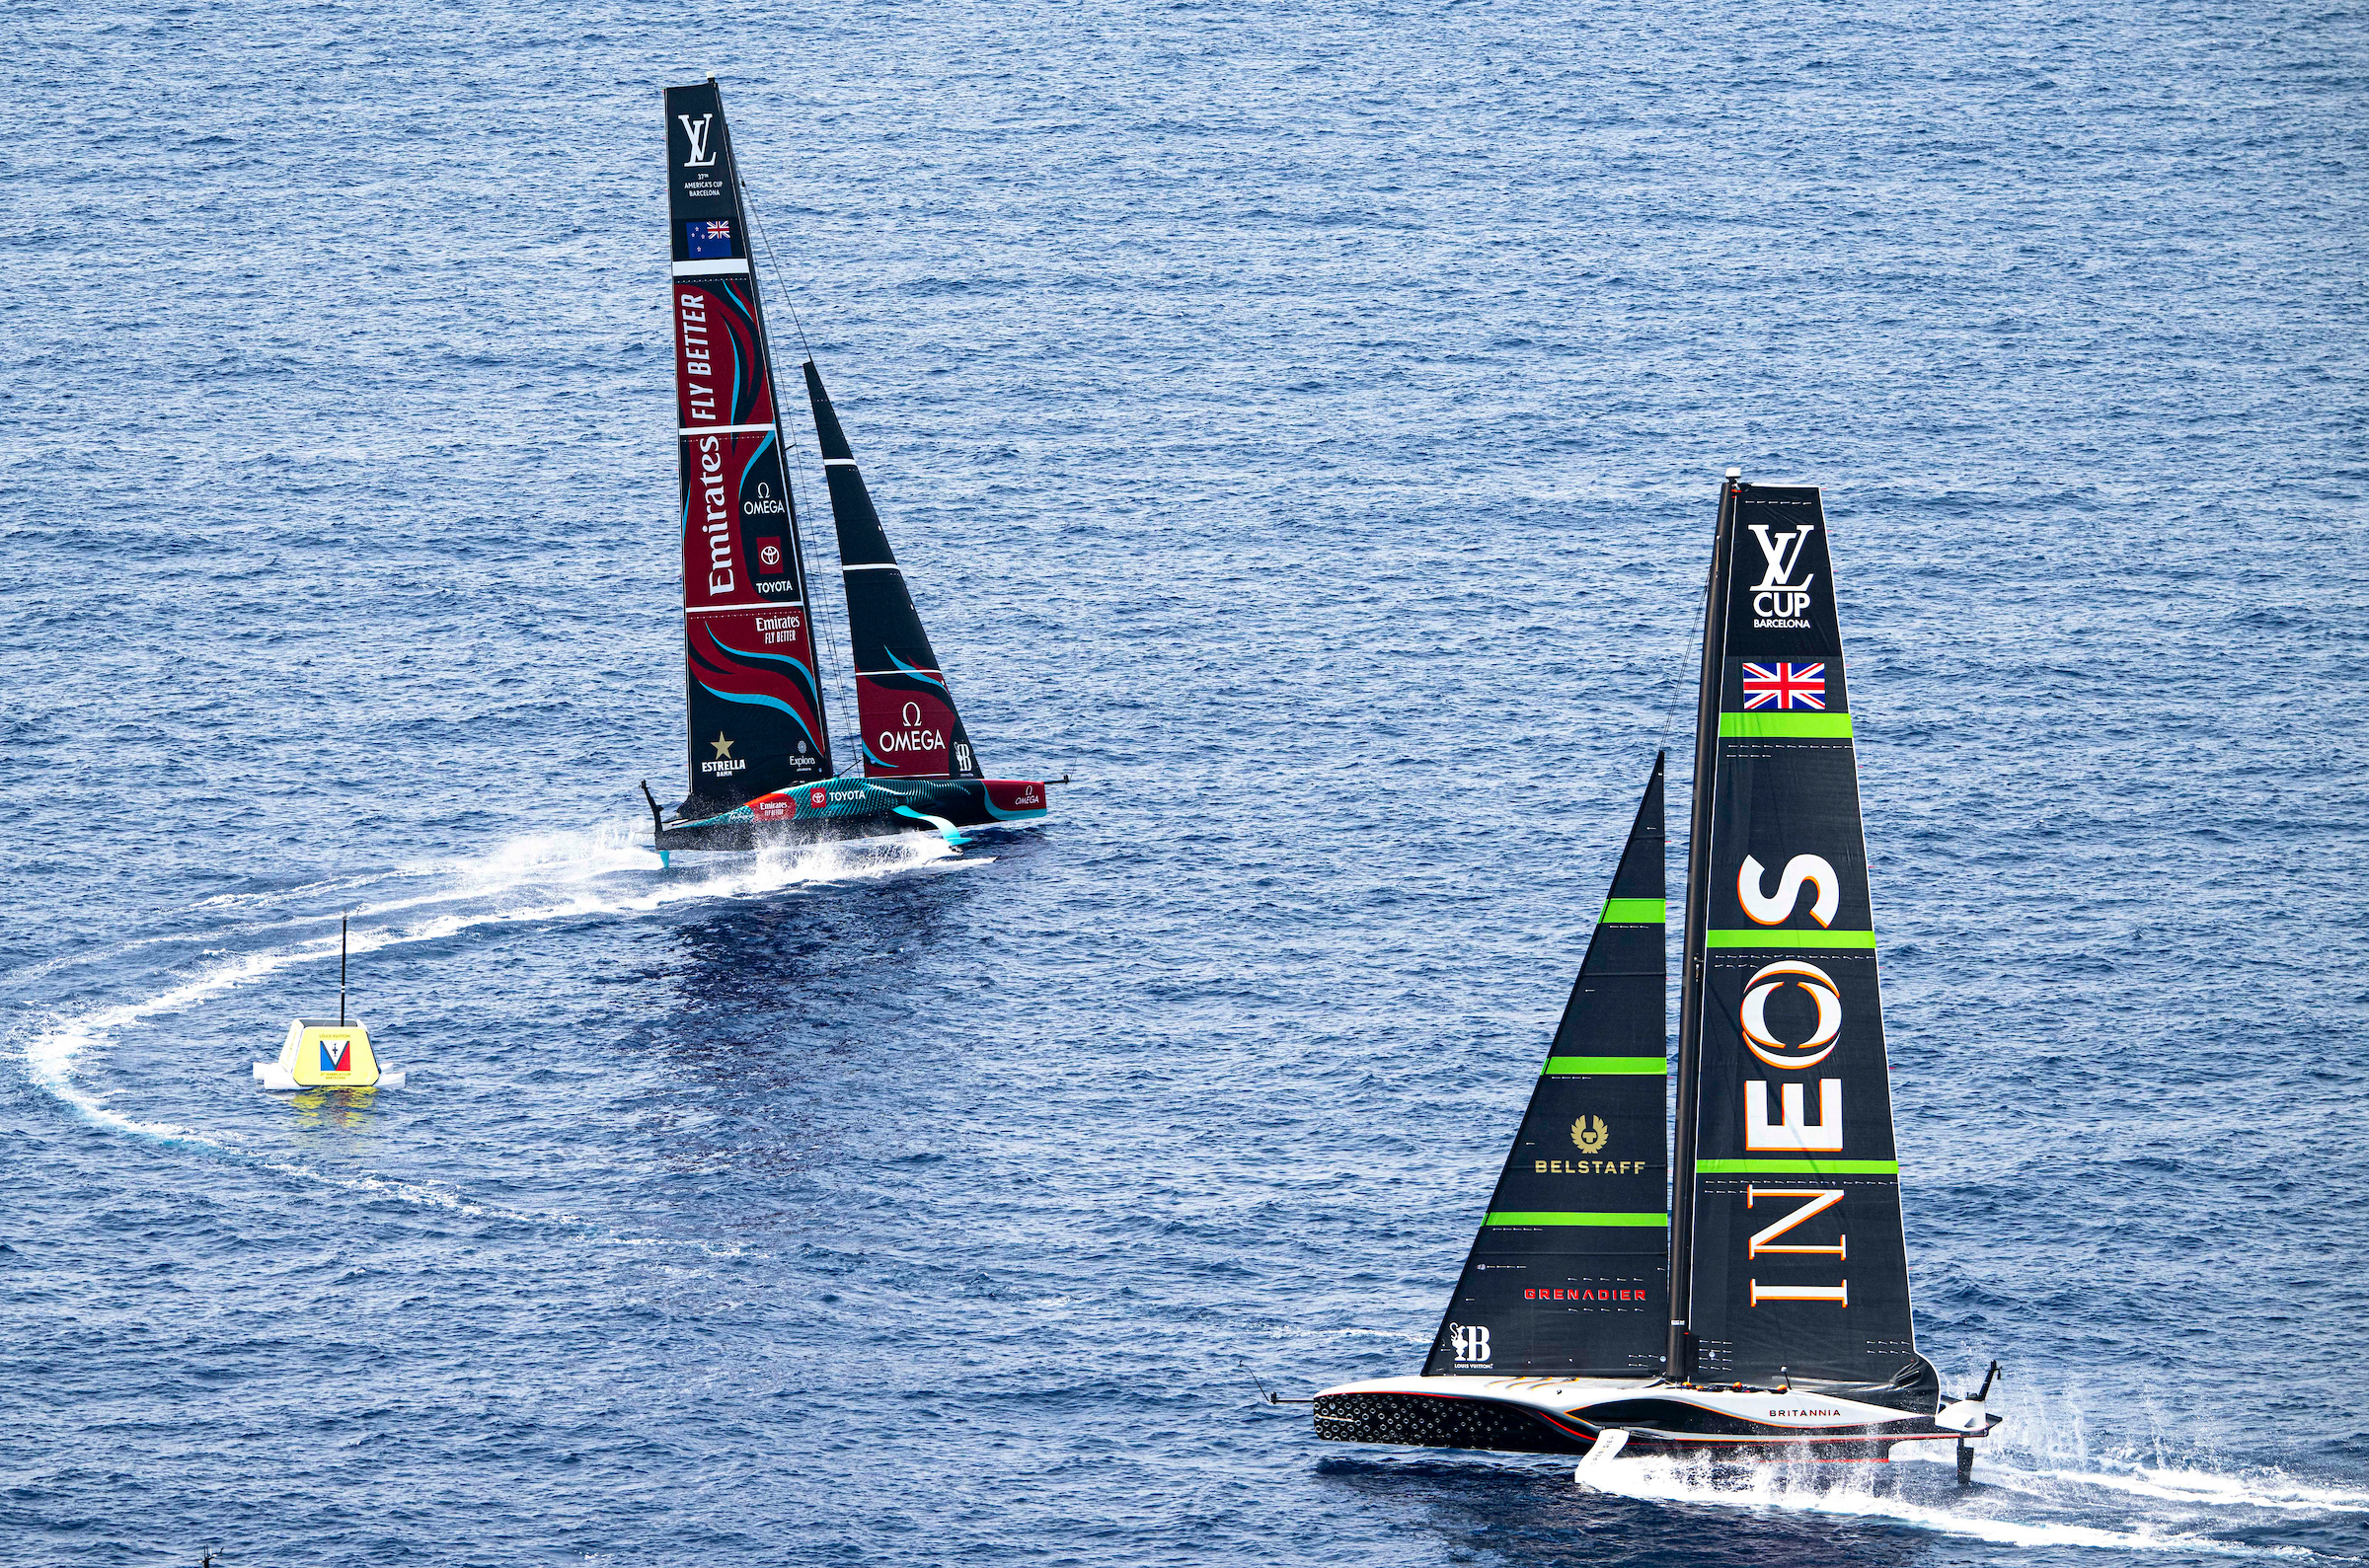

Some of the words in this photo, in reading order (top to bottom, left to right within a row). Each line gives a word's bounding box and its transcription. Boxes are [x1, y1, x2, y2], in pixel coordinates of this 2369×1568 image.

[681, 293, 712, 376] BETTER
[688, 383, 717, 420] FLY
[743, 500, 786, 515] OMEGA
[700, 435, 735, 597] Emirates
[756, 580, 793, 594] TOYOTA
[1753, 592, 1811, 618] CUP
[755, 615, 801, 632] Emirates
[1753, 619, 1811, 629] BARCELONA
[765, 632, 775, 644] FLY
[776, 630, 797, 643] BETTER
[879, 729, 947, 753] OMEGA
[701, 759, 746, 773] ESTRELLA
[790, 755, 816, 767] Explora
[829, 789, 866, 802] TOYOTA
[1015, 794, 1039, 805] OMEGA
[1737, 854, 1848, 1308] INEOS
[1535, 1159, 1646, 1174] BELSTAFF
[1524, 1288, 1646, 1301] GRENADIER
